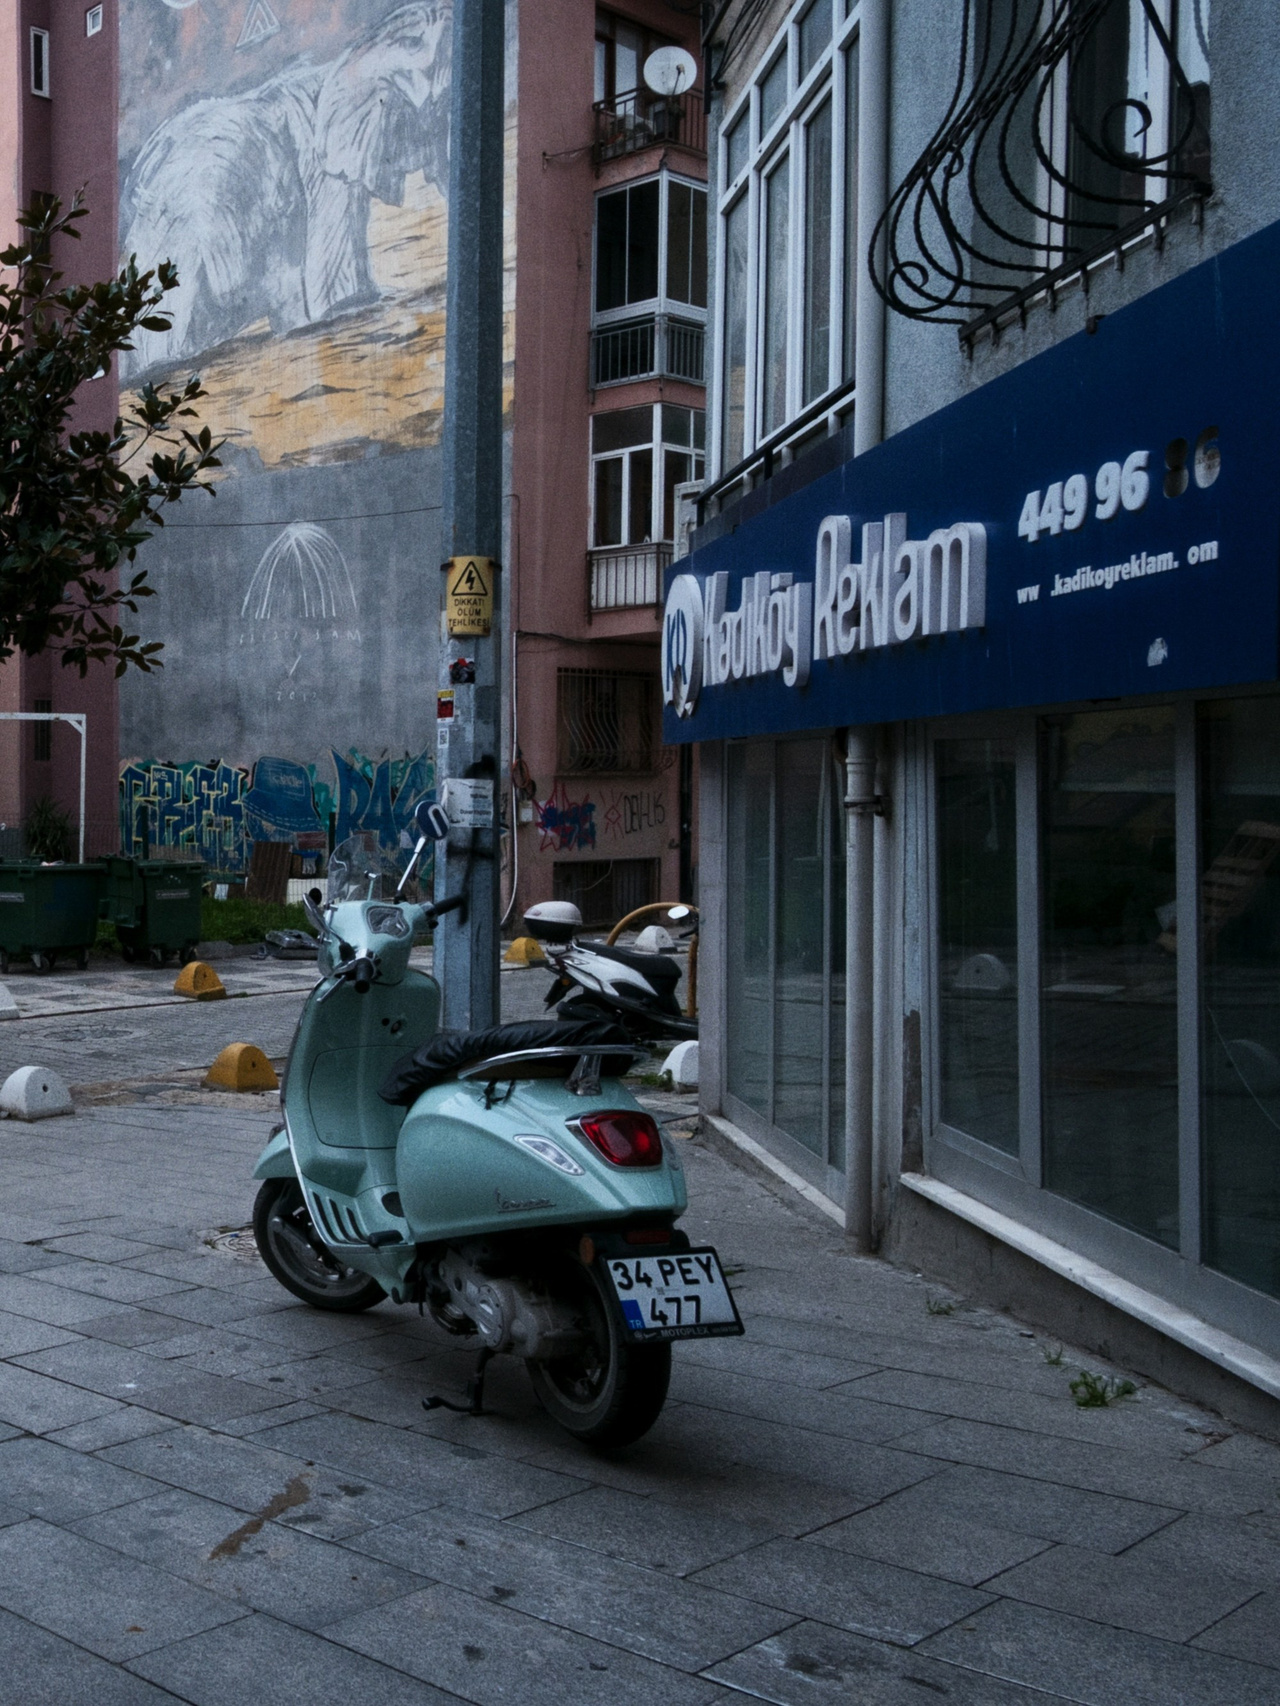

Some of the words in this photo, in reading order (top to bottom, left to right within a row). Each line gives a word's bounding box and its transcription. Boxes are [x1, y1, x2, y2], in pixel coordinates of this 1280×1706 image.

[1018, 473, 1088, 543] 449
[1095, 450, 1150, 520] 96
[814, 512, 987, 661] Reklam
[448, 618, 490, 627] TEHLİKESİ
[613, 1260, 652, 1291] 34
[657, 1256, 715, 1287] PEY
[630, 1320, 643, 1330] TR
[650, 1295, 701, 1326] 477
[660, 1327, 710, 1338] MOTOPLEX
